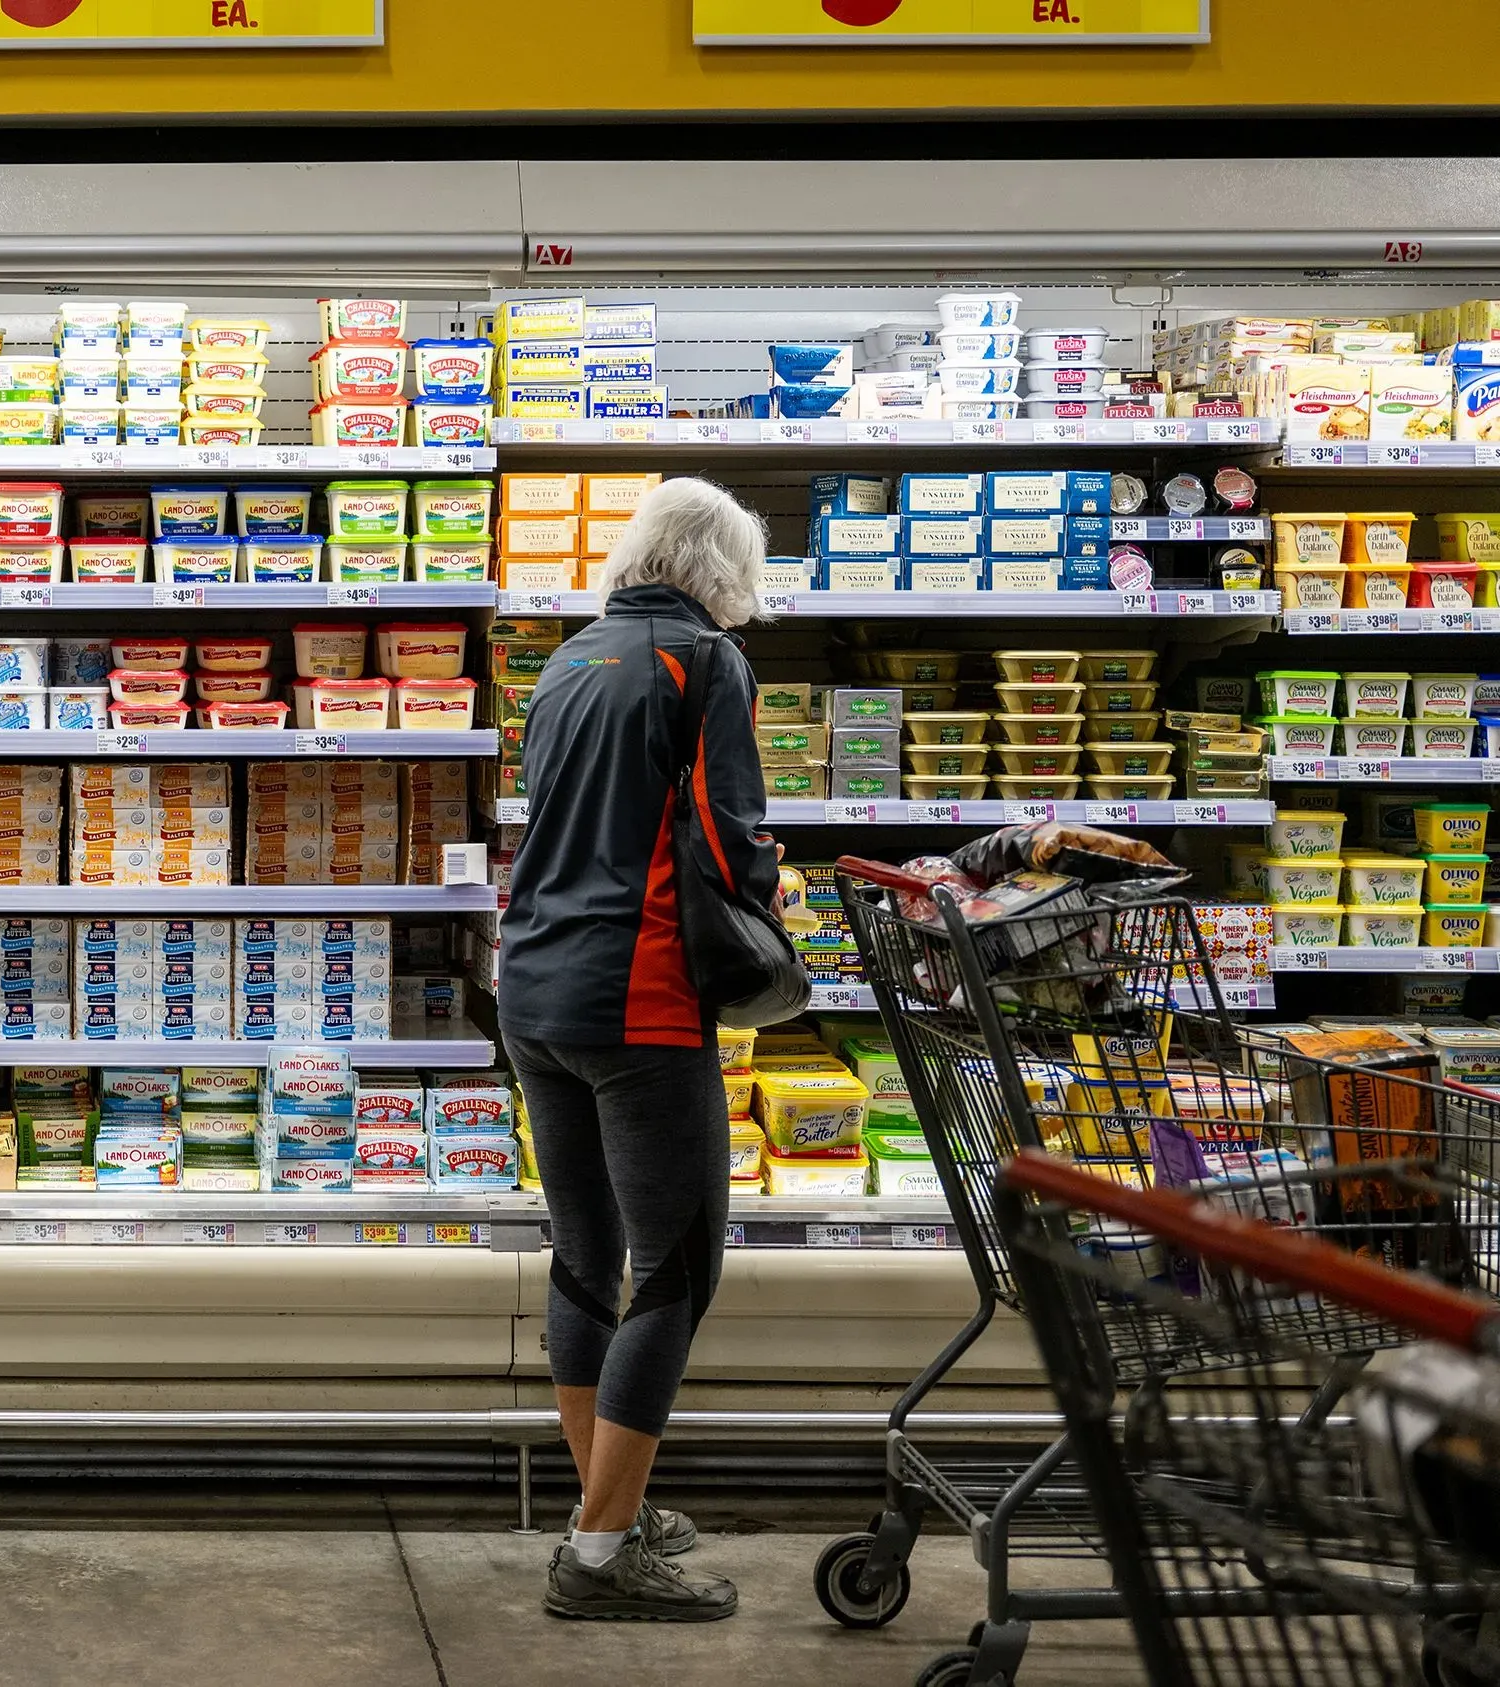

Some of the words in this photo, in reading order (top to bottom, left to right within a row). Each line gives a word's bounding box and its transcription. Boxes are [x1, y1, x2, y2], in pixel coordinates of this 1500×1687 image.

[212, 2, 257, 29] EA.
[1032, 0, 1081, 25] EA.
[537, 247, 572, 266] A7
[1386, 244, 1421, 264] A8
[344, 359, 392, 372] CHALLENGE
[596, 366, 636, 377] BUTTER
[1301, 391, 1356, 402] Fleischmann's
[1385, 391, 1439, 402] Fleischmann's
[431, 420, 477, 432] CHALLENGE
[164, 505, 183, 515] LAND
[195, 505, 215, 515] LAKES
[841, 532, 883, 540] UNSALTED
[1299, 532, 1320, 542] earth
[1303, 542, 1333, 551] balance
[1295, 683, 1321, 691] SMART
[1293, 690, 1324, 698] BALANCE
[1443, 820, 1480, 830] OLIVIO
[1290, 885, 1328, 903] Vegan
[1291, 934, 1328, 946] Vegan
[113, 1082, 133, 1093] LAND
[148, 1082, 170, 1093] LAKES
[283, 1081, 306, 1092] LAND
[320, 1082, 344, 1092] LAKES
[361, 1144, 415, 1158] CHALLENGE
[451, 1152, 504, 1166] CHALLENGE
